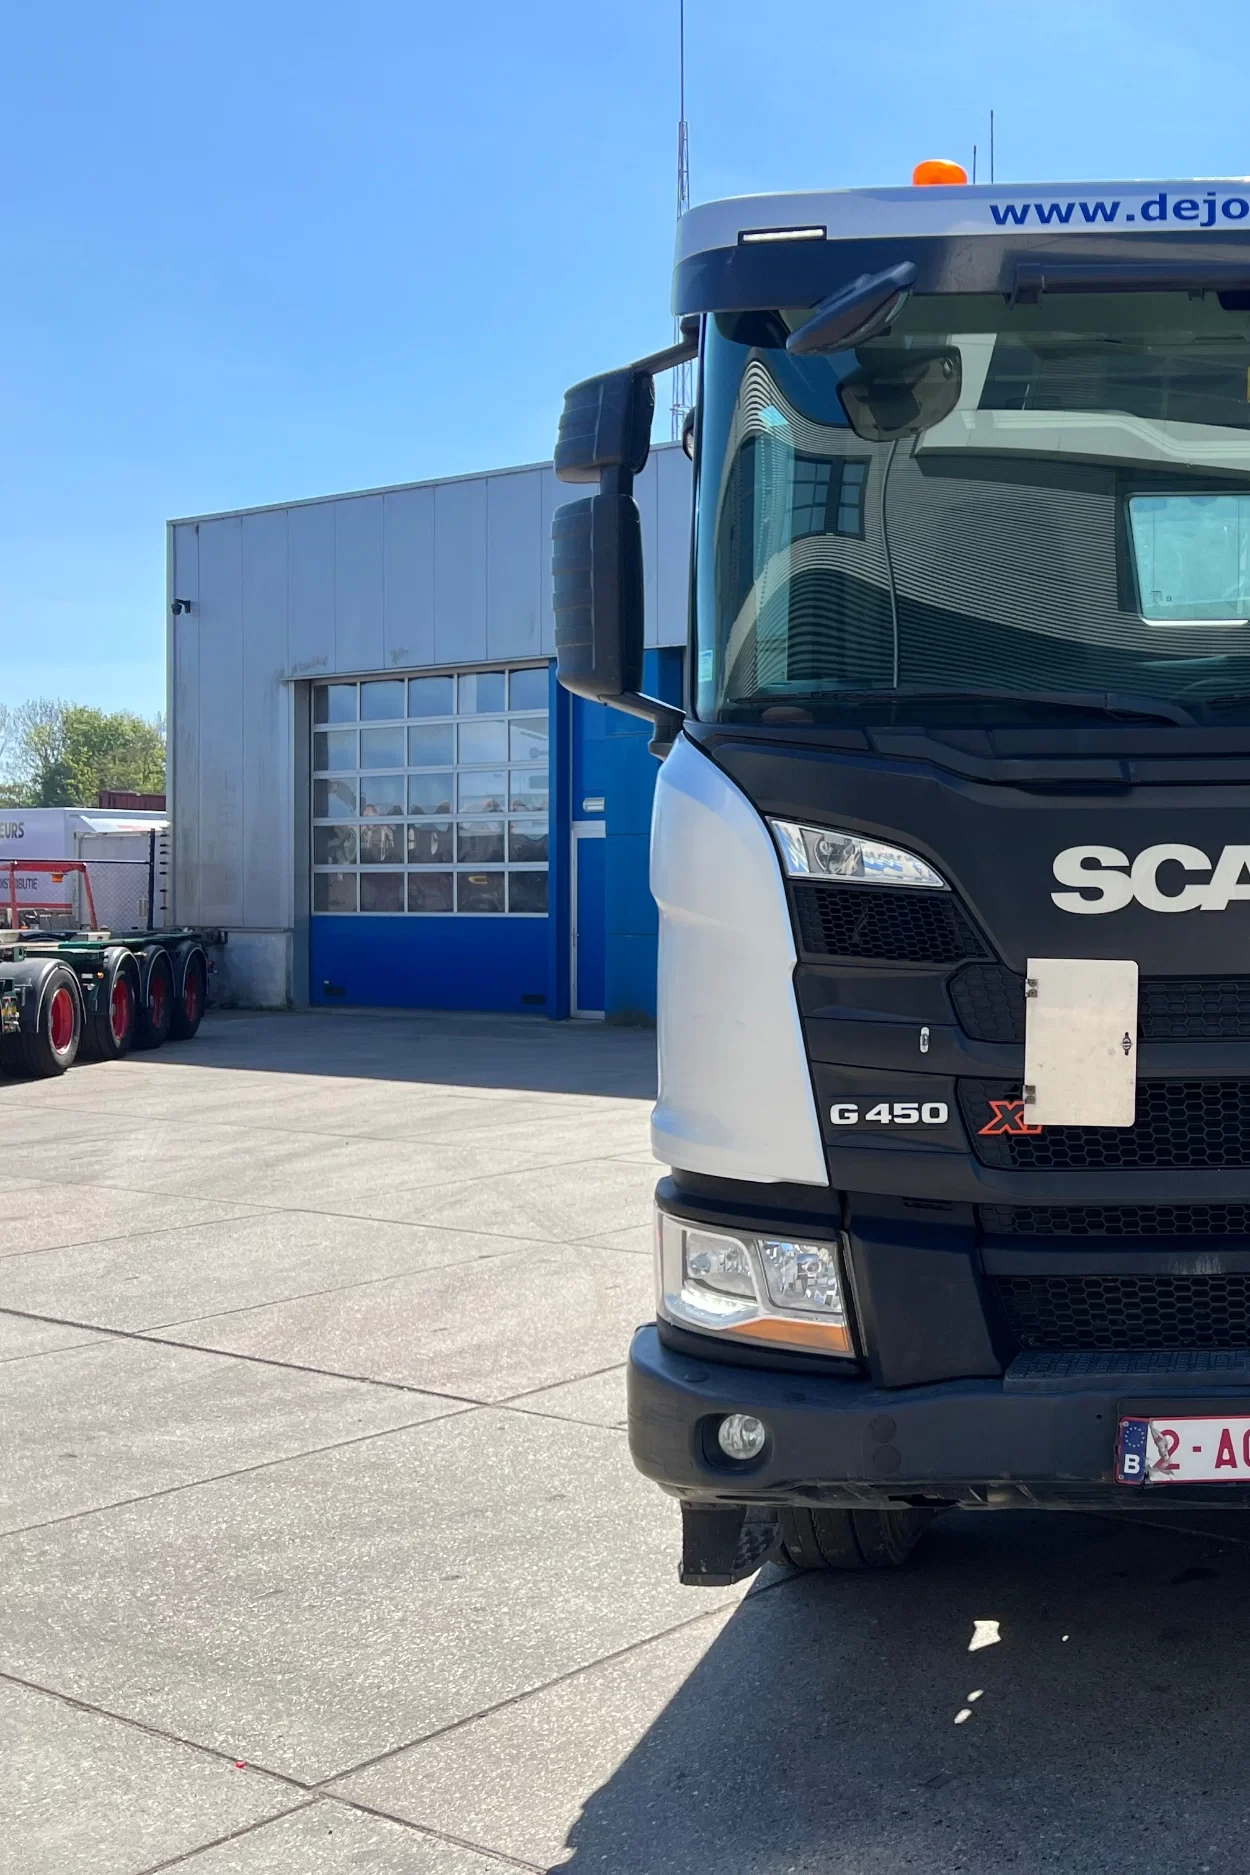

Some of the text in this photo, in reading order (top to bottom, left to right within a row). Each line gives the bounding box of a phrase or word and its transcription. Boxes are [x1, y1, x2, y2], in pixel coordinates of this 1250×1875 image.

[829, 1102, 948, 1125] G 450
[1123, 1453, 1141, 1474] B
